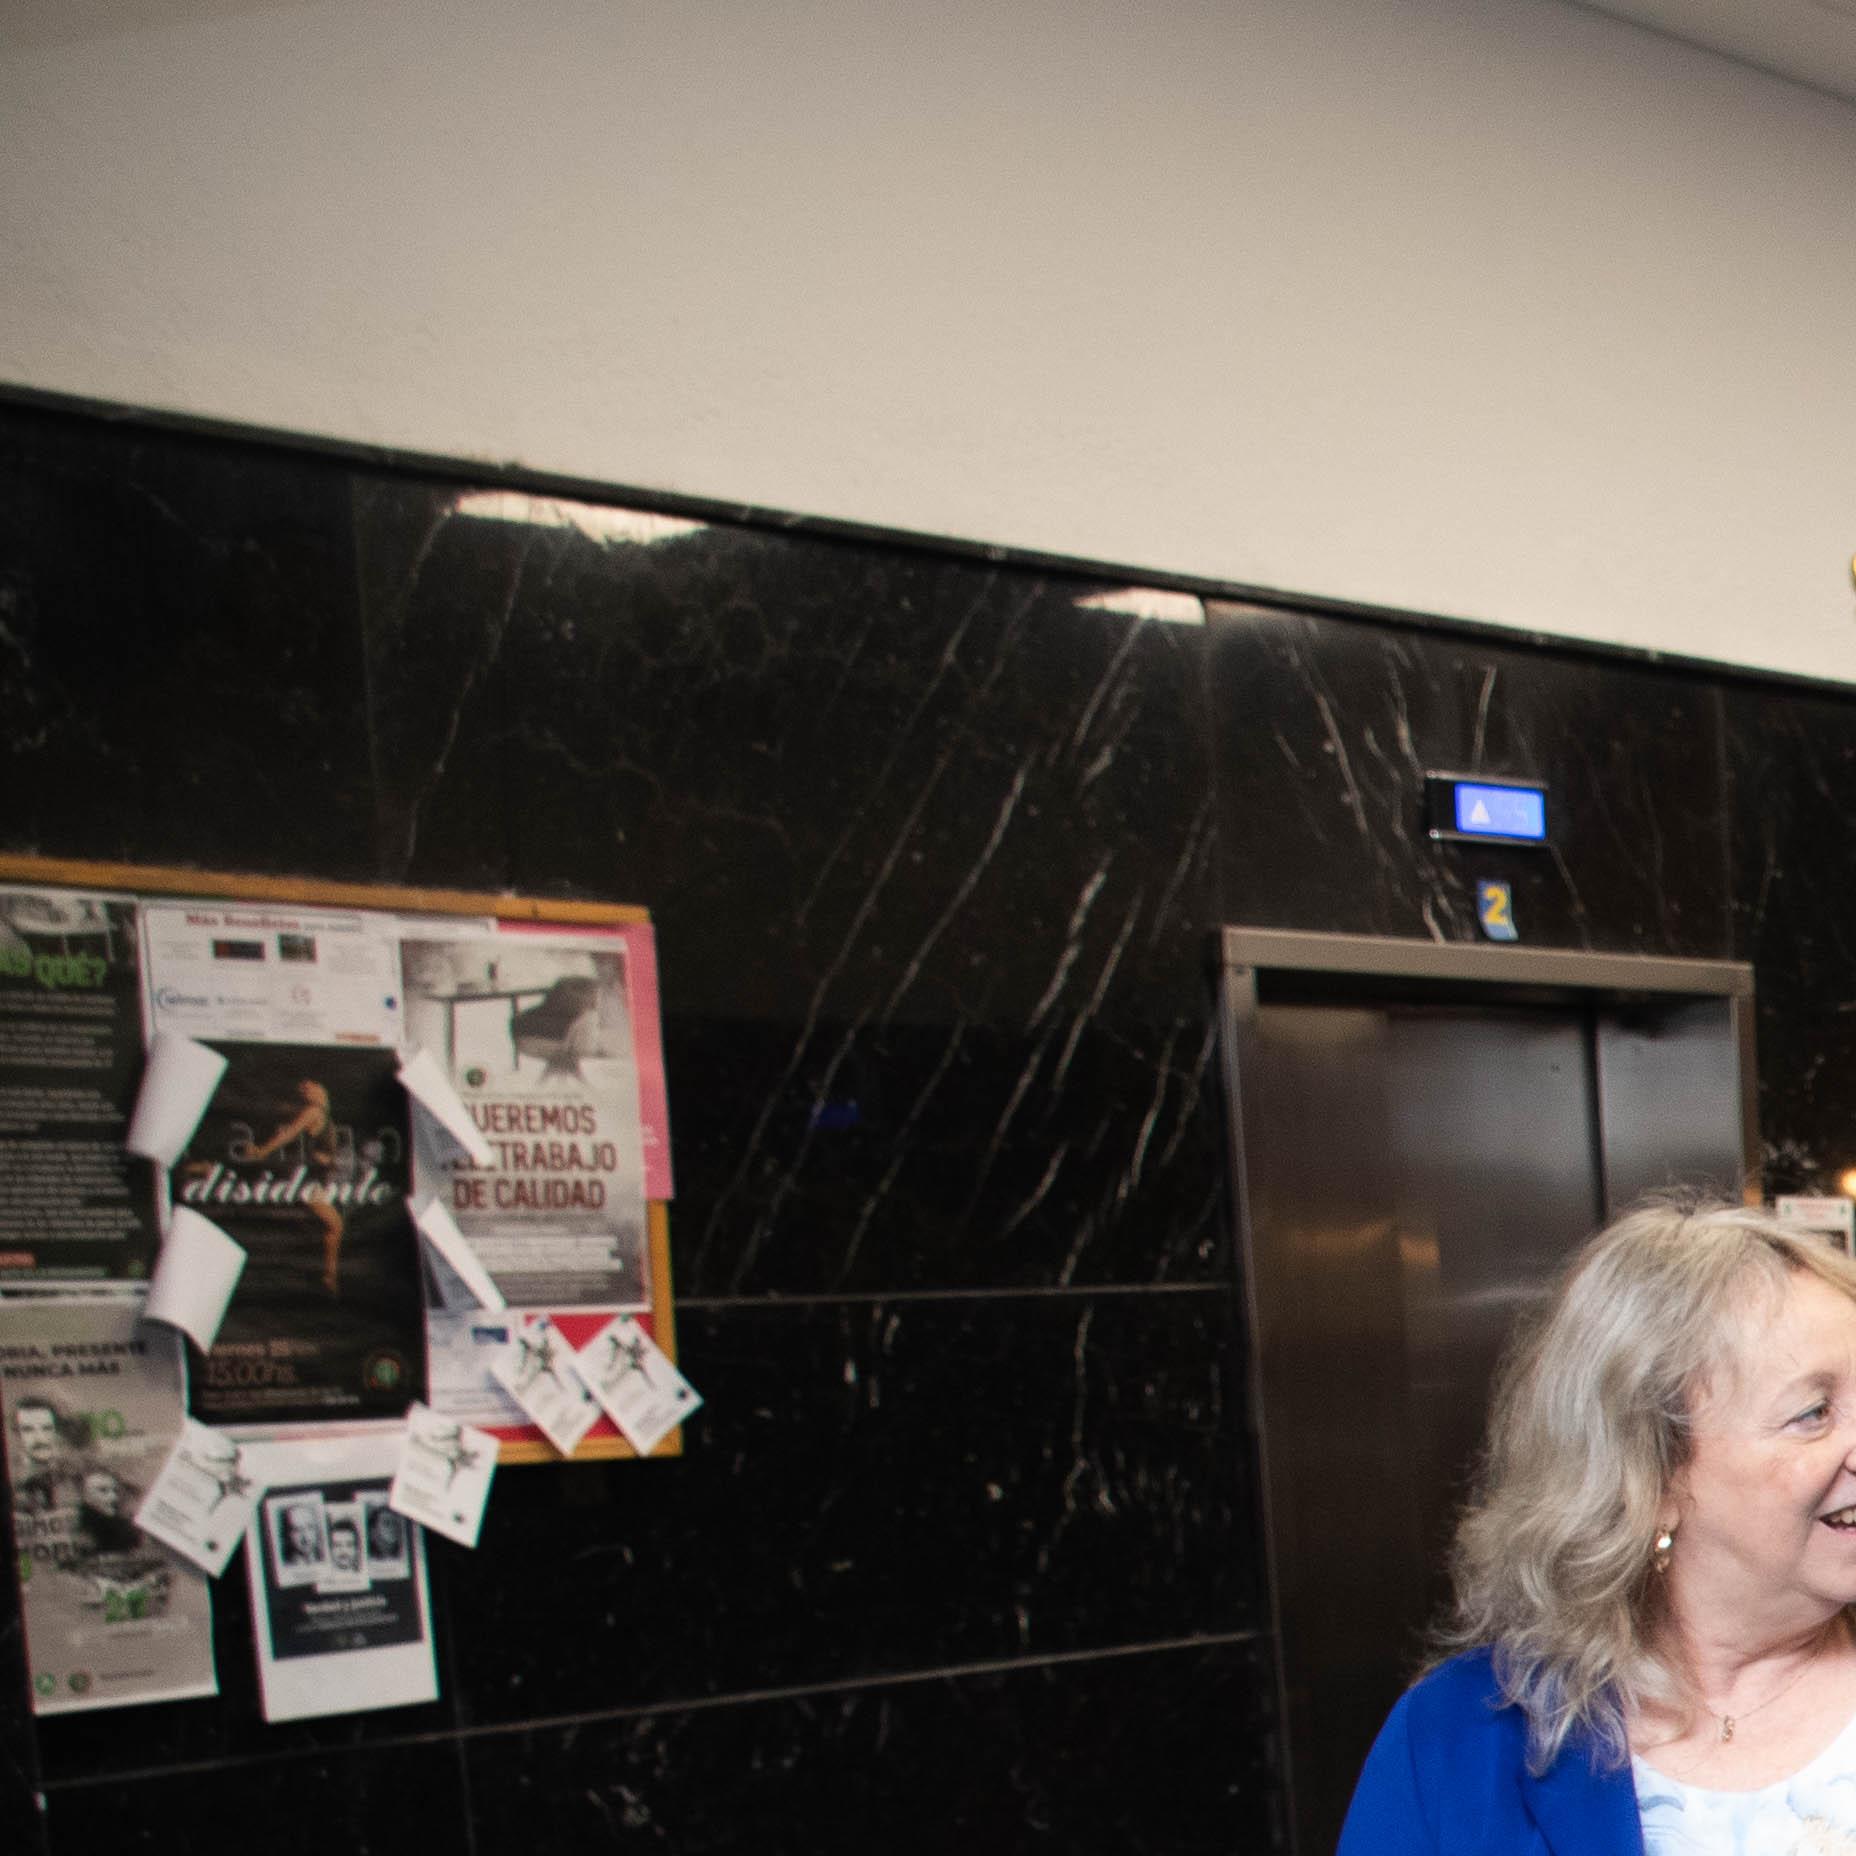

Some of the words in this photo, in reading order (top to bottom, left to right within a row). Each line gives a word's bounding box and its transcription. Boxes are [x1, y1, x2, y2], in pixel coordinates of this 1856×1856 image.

[1484, 886, 1508, 925] 2
[466, 1103, 597, 1135] UEREMOS
[182, 1161, 396, 1205] disidente
[452, 1178, 487, 1210] DE
[495, 1178, 606, 1210] CALIDAD
